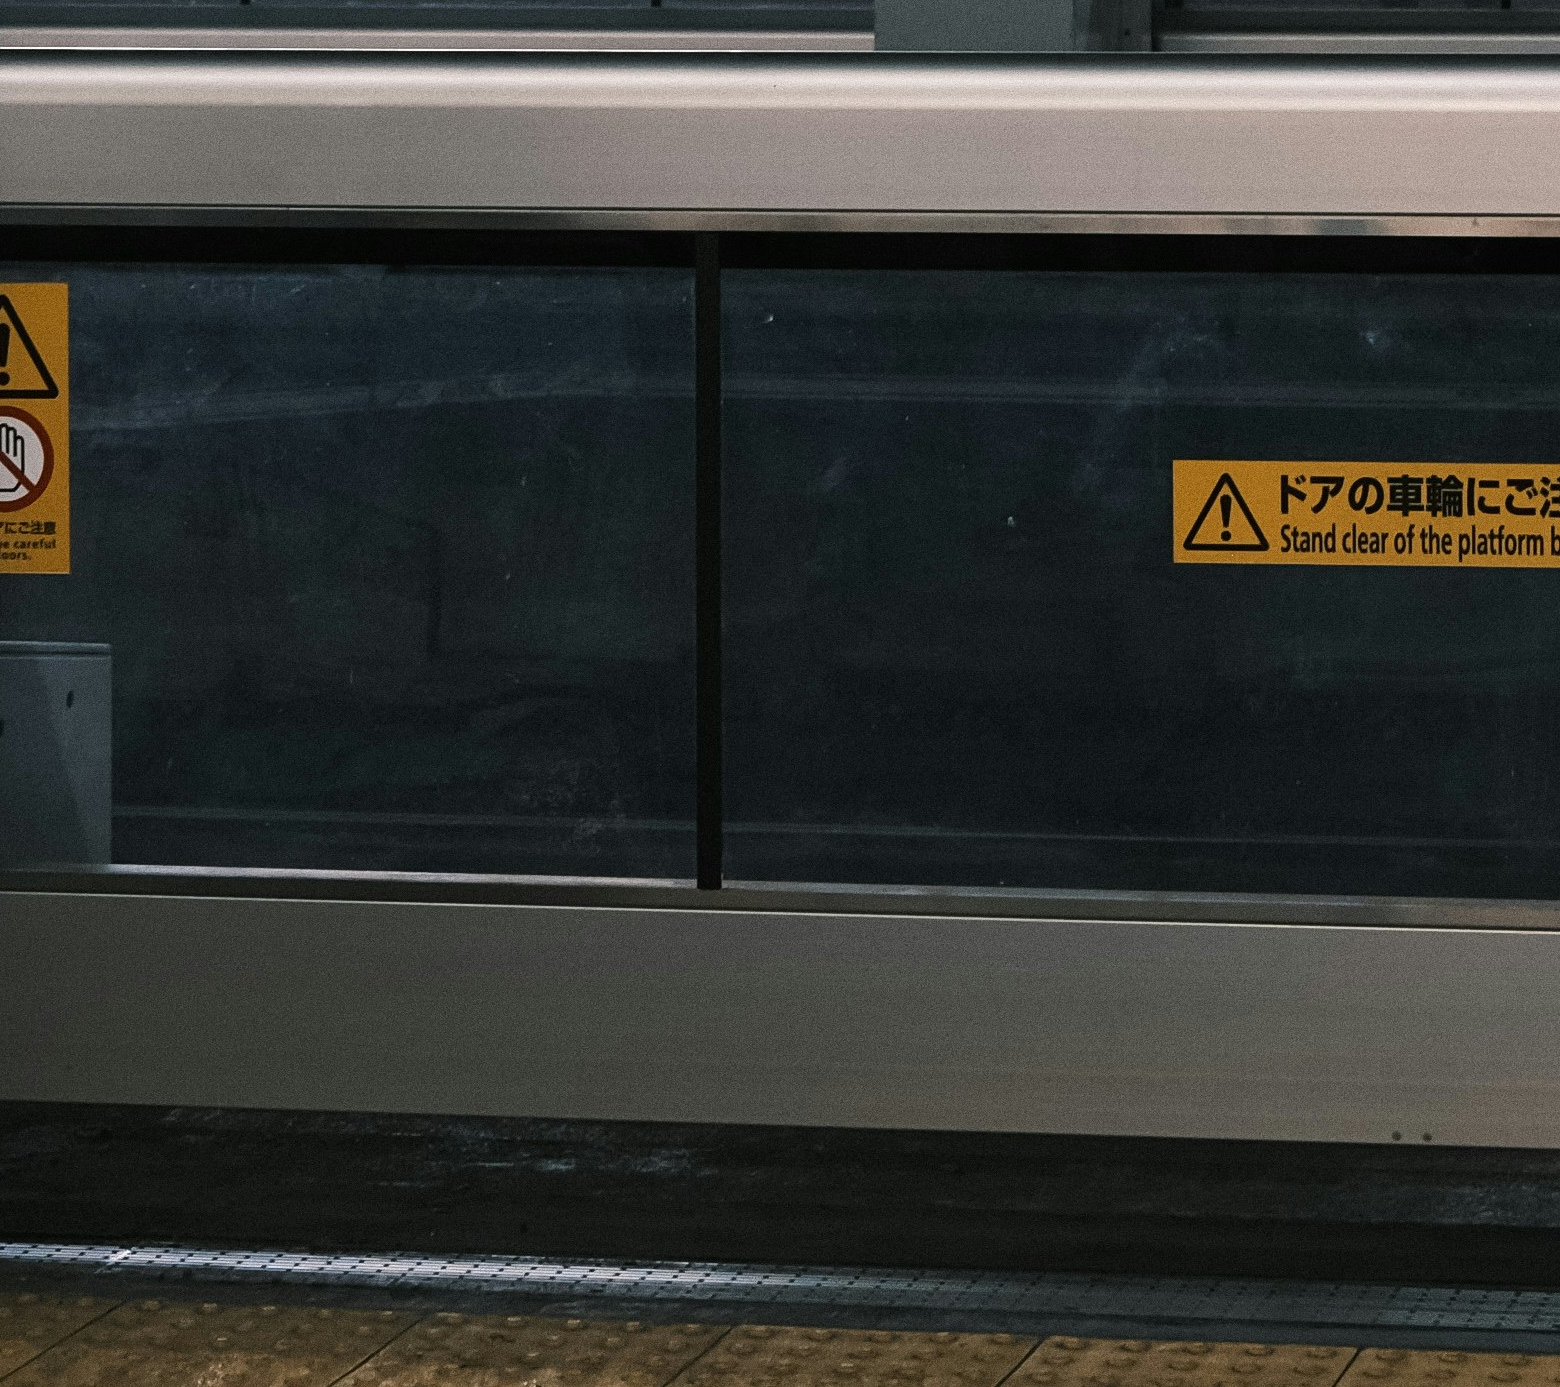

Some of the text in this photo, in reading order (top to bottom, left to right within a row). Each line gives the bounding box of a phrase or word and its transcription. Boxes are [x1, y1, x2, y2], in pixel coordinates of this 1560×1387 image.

[13, 538, 56, 548] careful
[1281, 522, 1336, 554] Stand
[1342, 522, 1388, 554] clear
[1394, 524, 1416, 554] of
[1420, 524, 1452, 555] the
[1458, 524, 1544, 562] platform
